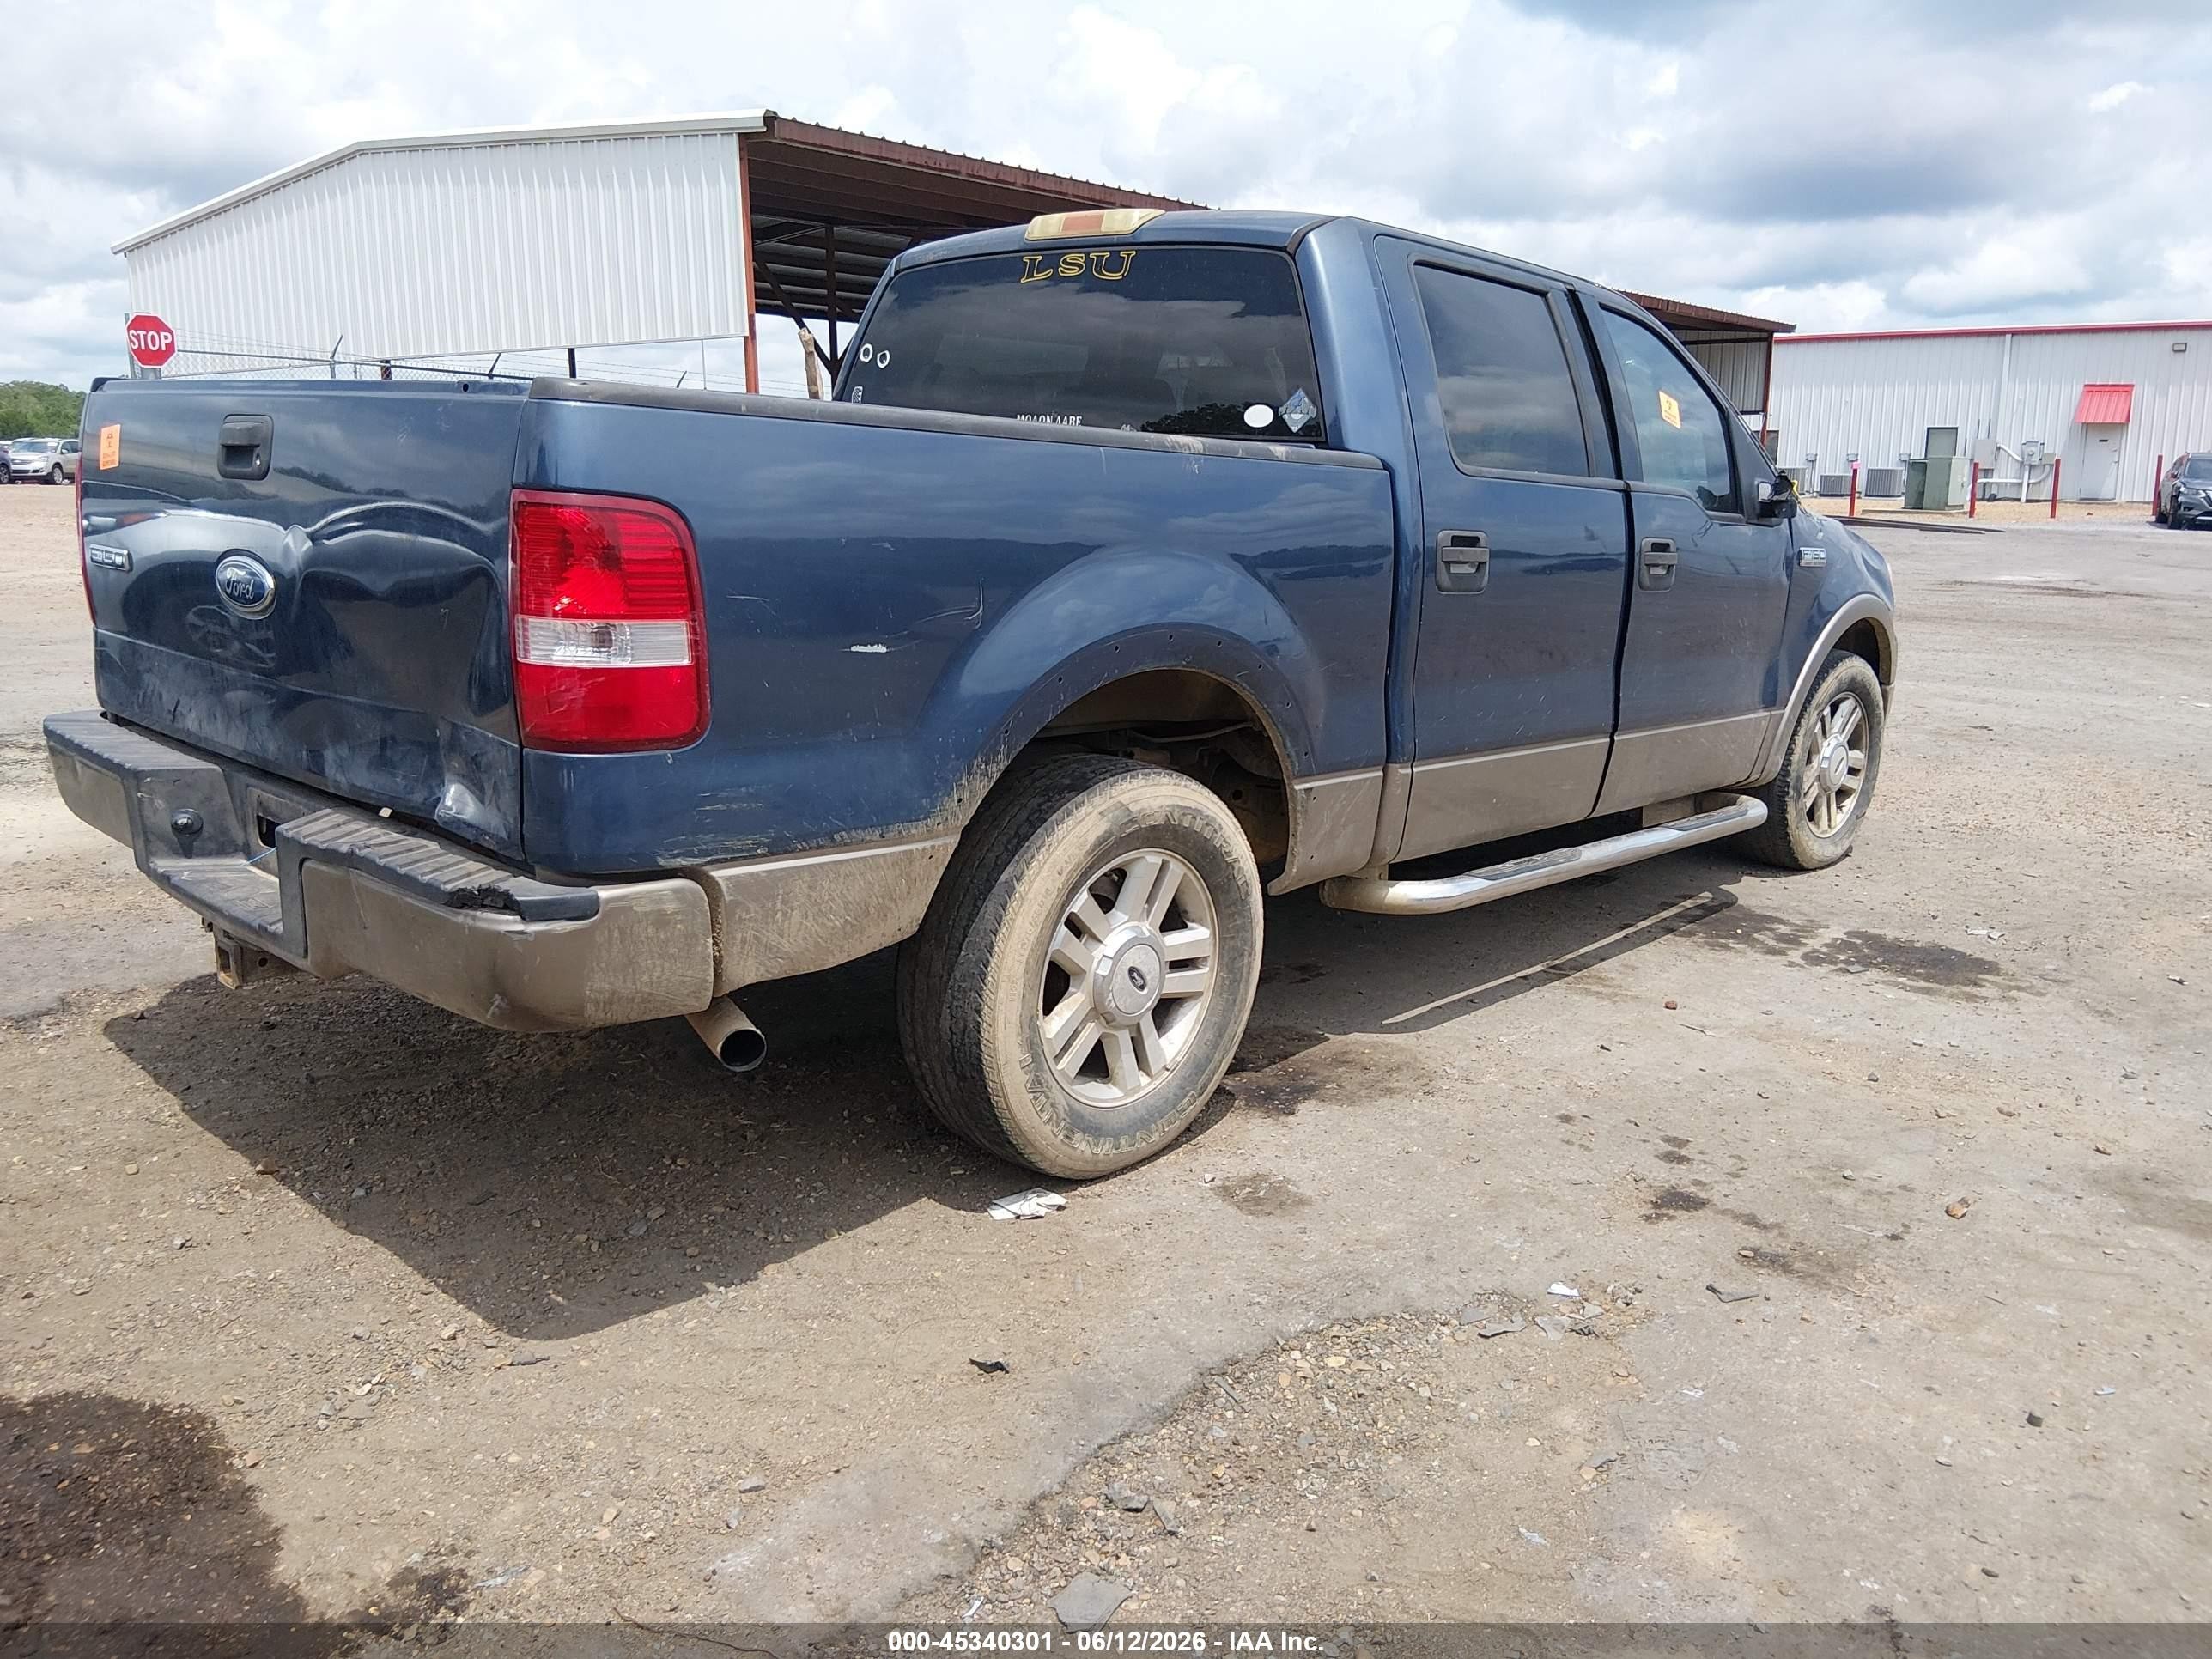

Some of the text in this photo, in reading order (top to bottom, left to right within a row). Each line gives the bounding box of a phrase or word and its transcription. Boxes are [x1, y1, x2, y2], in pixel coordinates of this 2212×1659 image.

[1020, 251, 1137, 283] LSU
[129, 329, 173, 351] STOP
[226, 567, 255, 599] Ford
